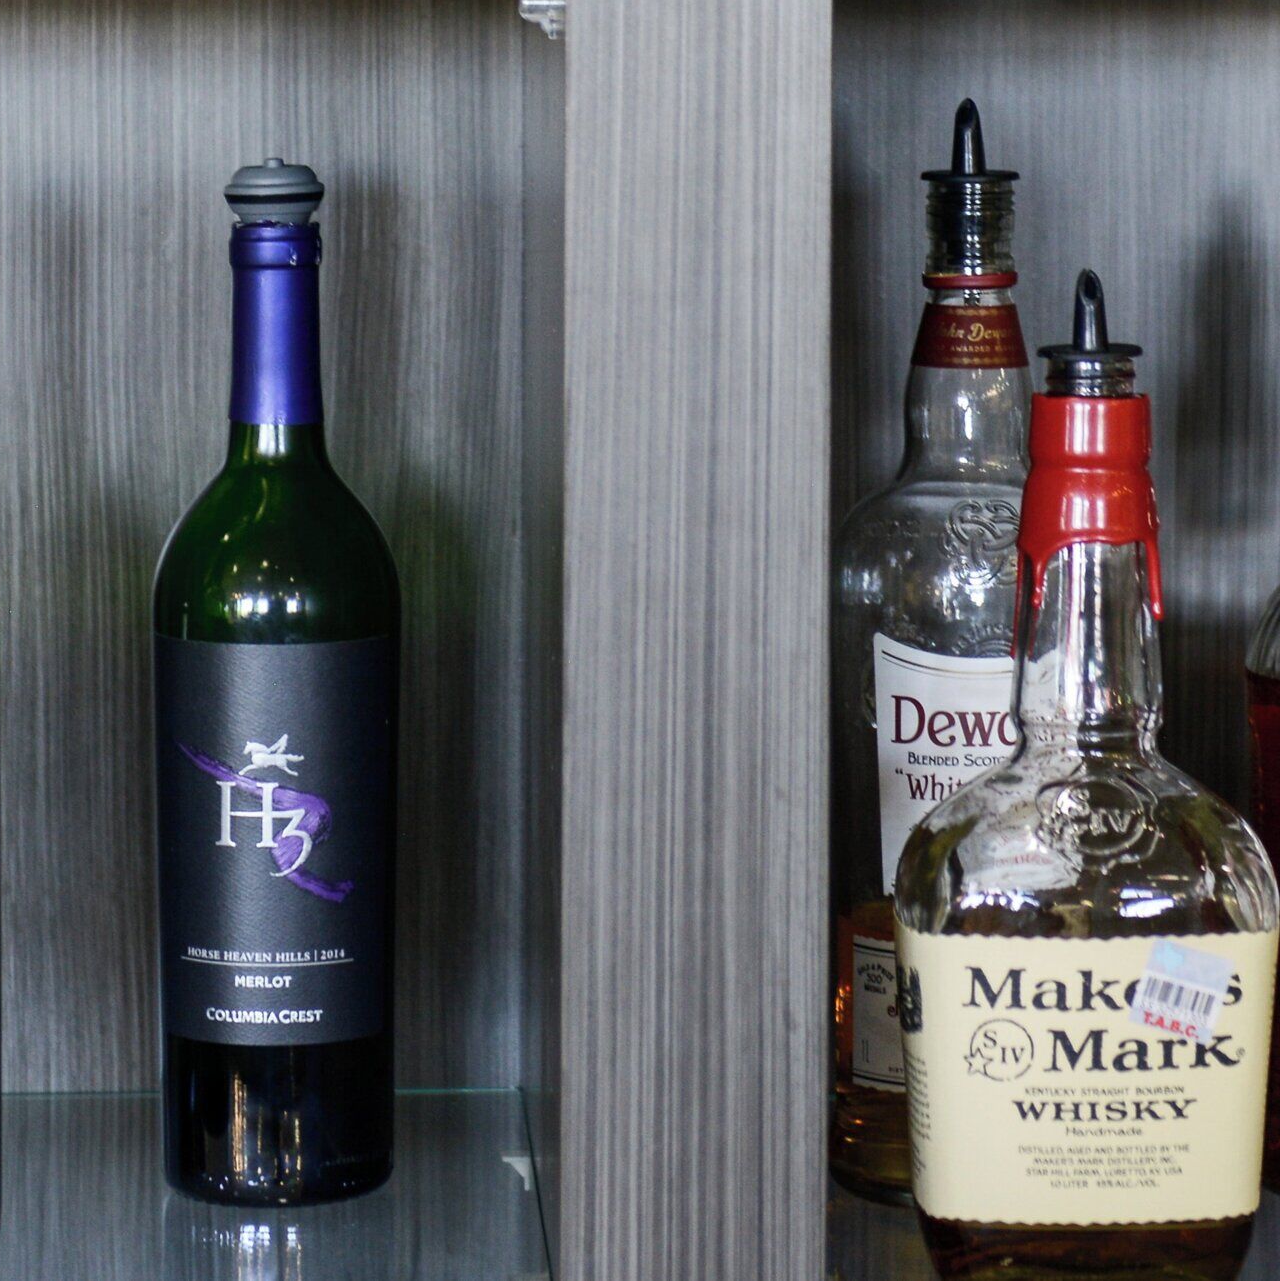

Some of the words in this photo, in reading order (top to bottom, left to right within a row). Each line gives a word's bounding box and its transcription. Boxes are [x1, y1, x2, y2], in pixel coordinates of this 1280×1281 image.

[907, 751, 960, 767] BLENDED
[187, 946, 220, 960] HORSE
[223, 950, 271, 963] HEAVEN
[276, 951, 310, 962] HILLS
[320, 948, 345, 960] 2014
[234, 975, 292, 989] MERLOT
[206, 1007, 278, 1024] COLUMBIA
[279, 1009, 323, 1024] CREST
[1142, 1010, 1200, 1040] T.A.B.C.
[1042, 1029, 1241, 1073] Mark
[1081, 1087, 1131, 1096] STRAIGHT
[1135, 1086, 1185, 1095] BOURBON
[1011, 1098, 1198, 1121] WHISKY
[1065, 1125, 1143, 1137] Handmade
